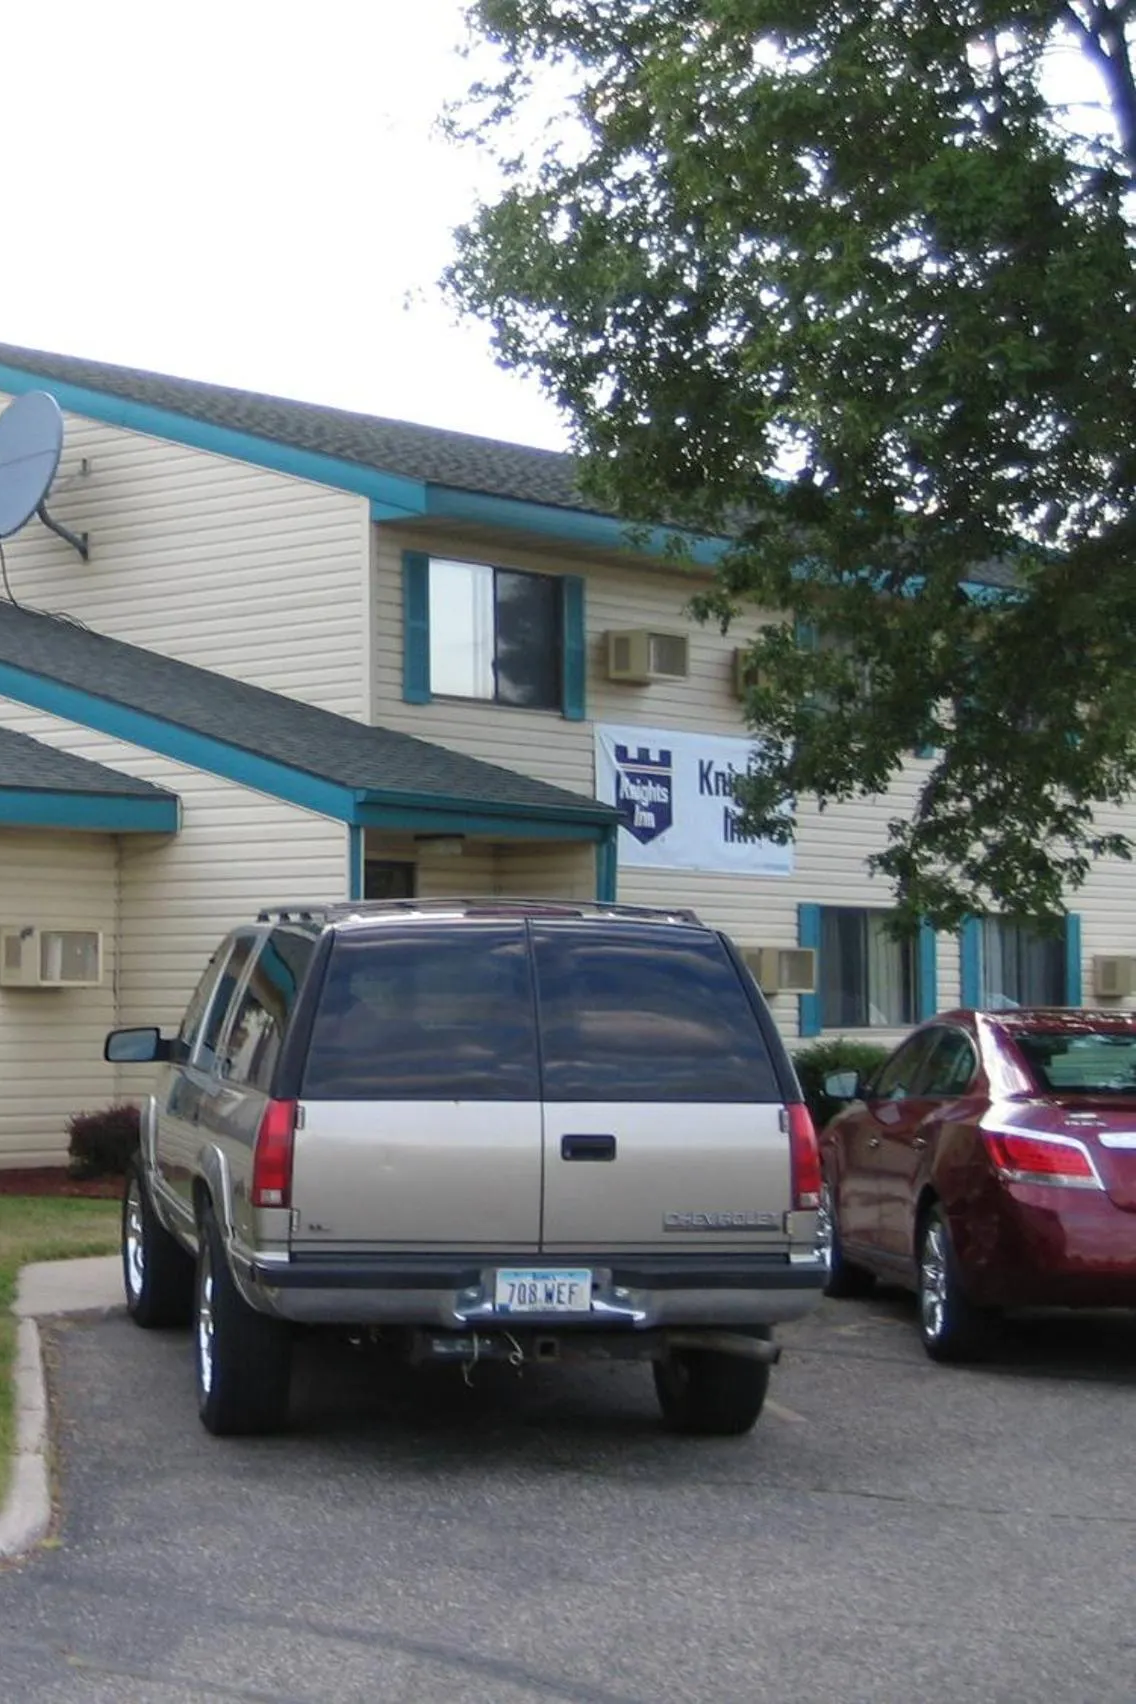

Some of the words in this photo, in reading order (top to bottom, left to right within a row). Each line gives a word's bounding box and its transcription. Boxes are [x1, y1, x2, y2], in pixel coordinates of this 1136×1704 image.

[620, 776, 669, 807] Knights
[634, 804, 656, 829] Inn
[665, 1211, 779, 1226] CHEVROLET
[507, 1282, 538, 1305] 708
